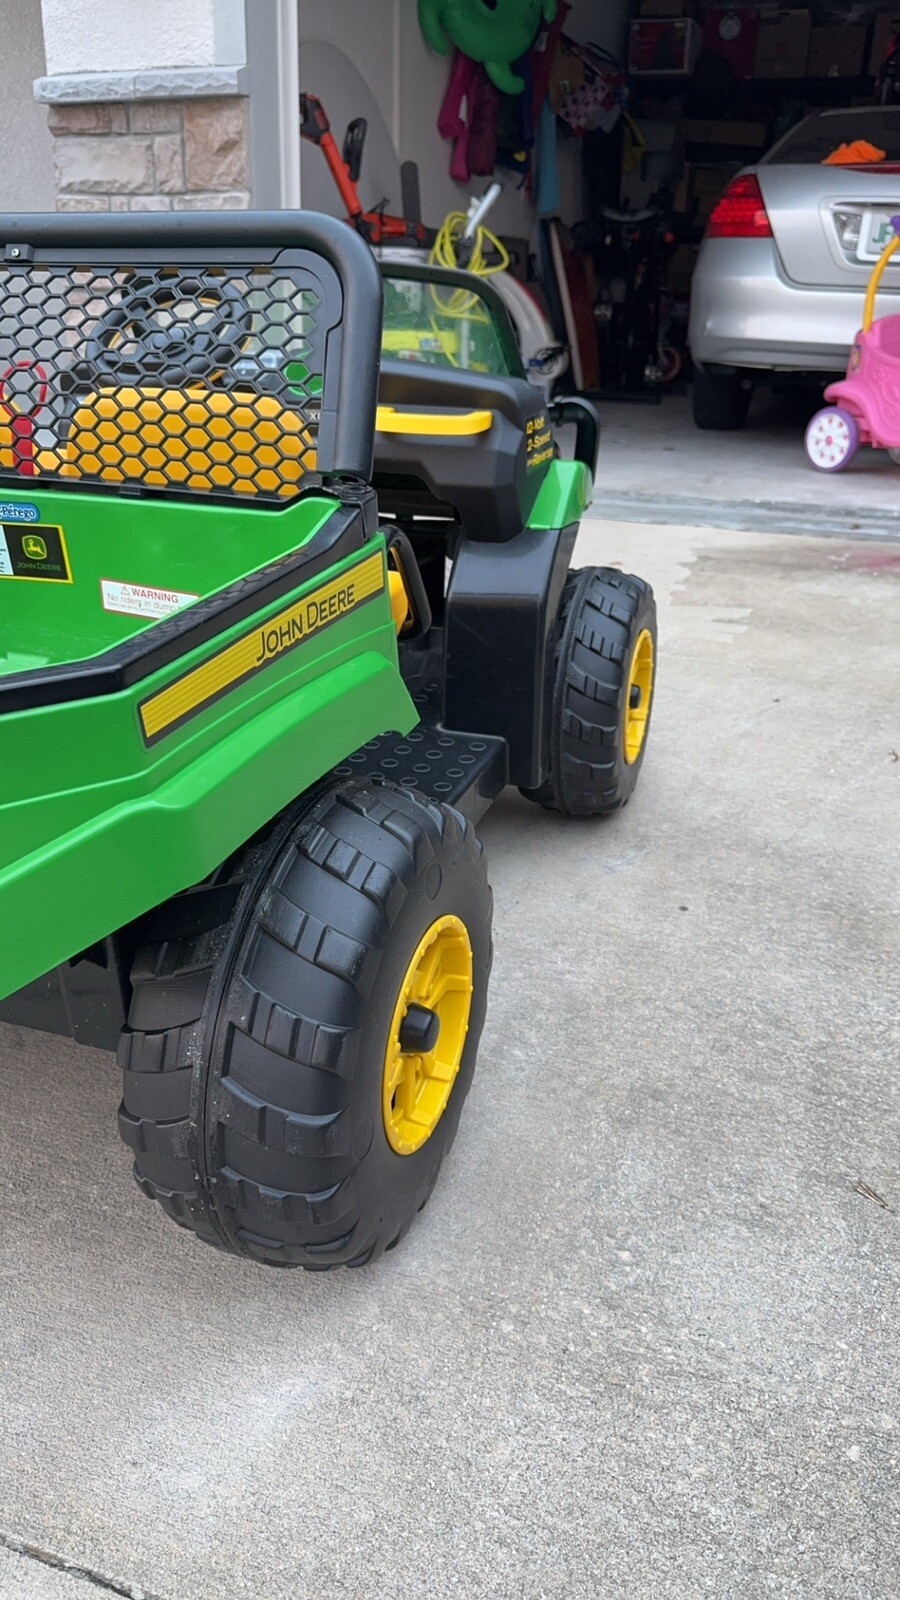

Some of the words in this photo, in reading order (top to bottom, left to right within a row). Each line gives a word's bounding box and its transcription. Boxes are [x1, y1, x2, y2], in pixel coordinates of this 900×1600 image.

[17, 562, 37, 570] JOHN
[37, 562, 62, 572] DEERE
[107, 592, 119, 602] No
[120, 596, 142, 607] riders
[144, 599, 152, 608] in
[153, 601, 176, 612] dump
[131, 587, 179, 604] WARNING
[256, 613, 303, 663] JOHN
[306, 583, 355, 630] DEERE
